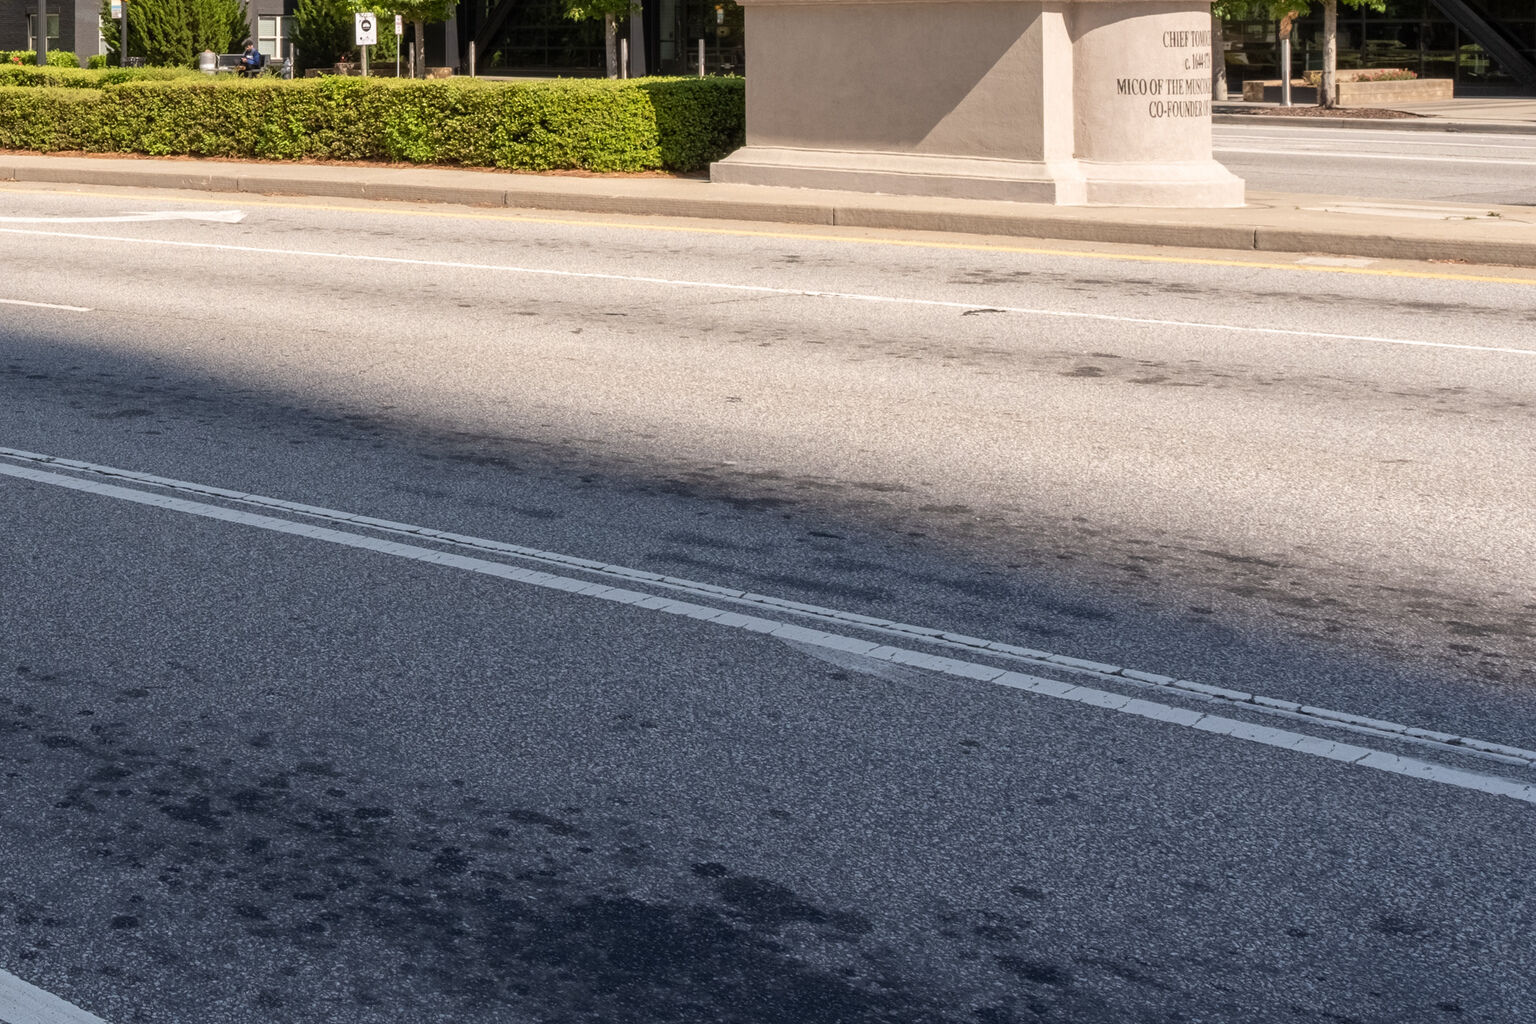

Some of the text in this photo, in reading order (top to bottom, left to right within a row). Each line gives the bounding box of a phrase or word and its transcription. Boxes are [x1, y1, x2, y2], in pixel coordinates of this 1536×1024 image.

[1163, 31, 1189, 48] CHIEF
[1117, 79, 1147, 95] MICO
[1149, 79, 1163, 95] OF
[1166, 79, 1184, 95] THE
[1149, 100, 1202, 118] CO-FOUNDER
